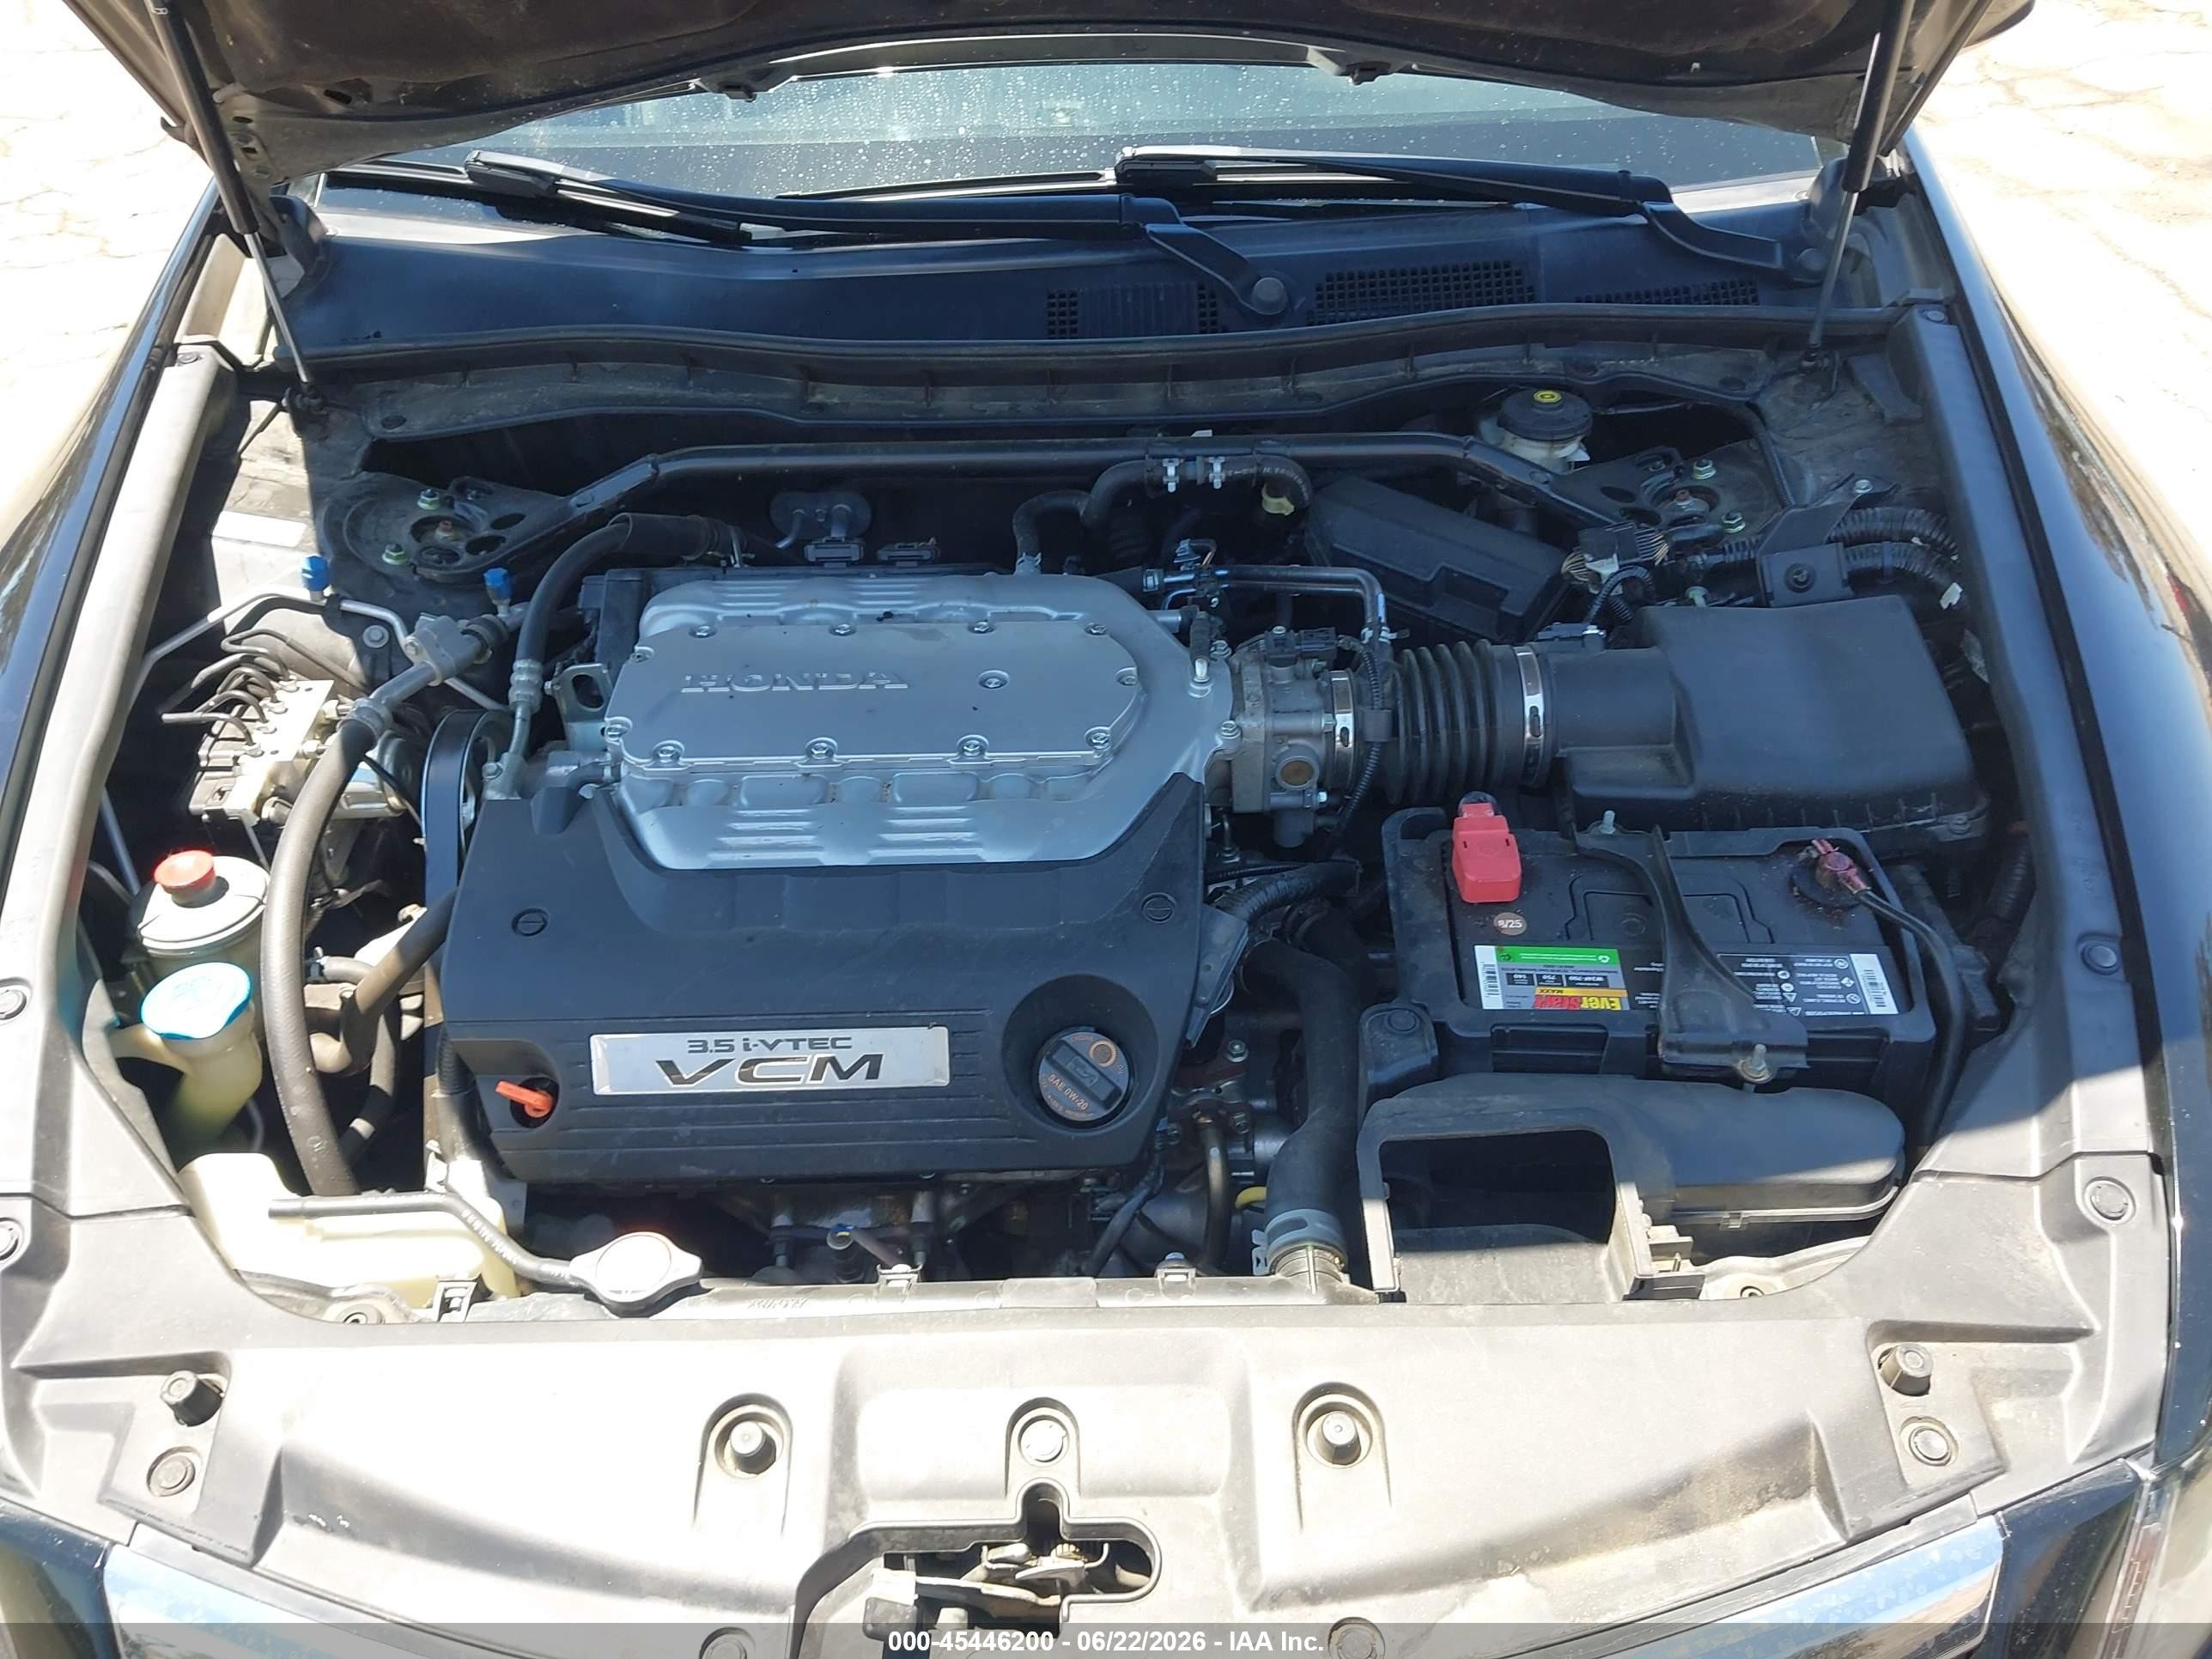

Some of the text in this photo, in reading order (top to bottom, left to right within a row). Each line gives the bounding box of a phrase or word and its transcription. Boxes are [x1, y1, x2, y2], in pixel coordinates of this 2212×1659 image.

[681, 671, 908, 693] HONDA
[1533, 994, 1622, 1011] EverStart
[687, 1036, 853, 1054] 3.5 i-VTEC
[655, 1054, 884, 1085] VCM
